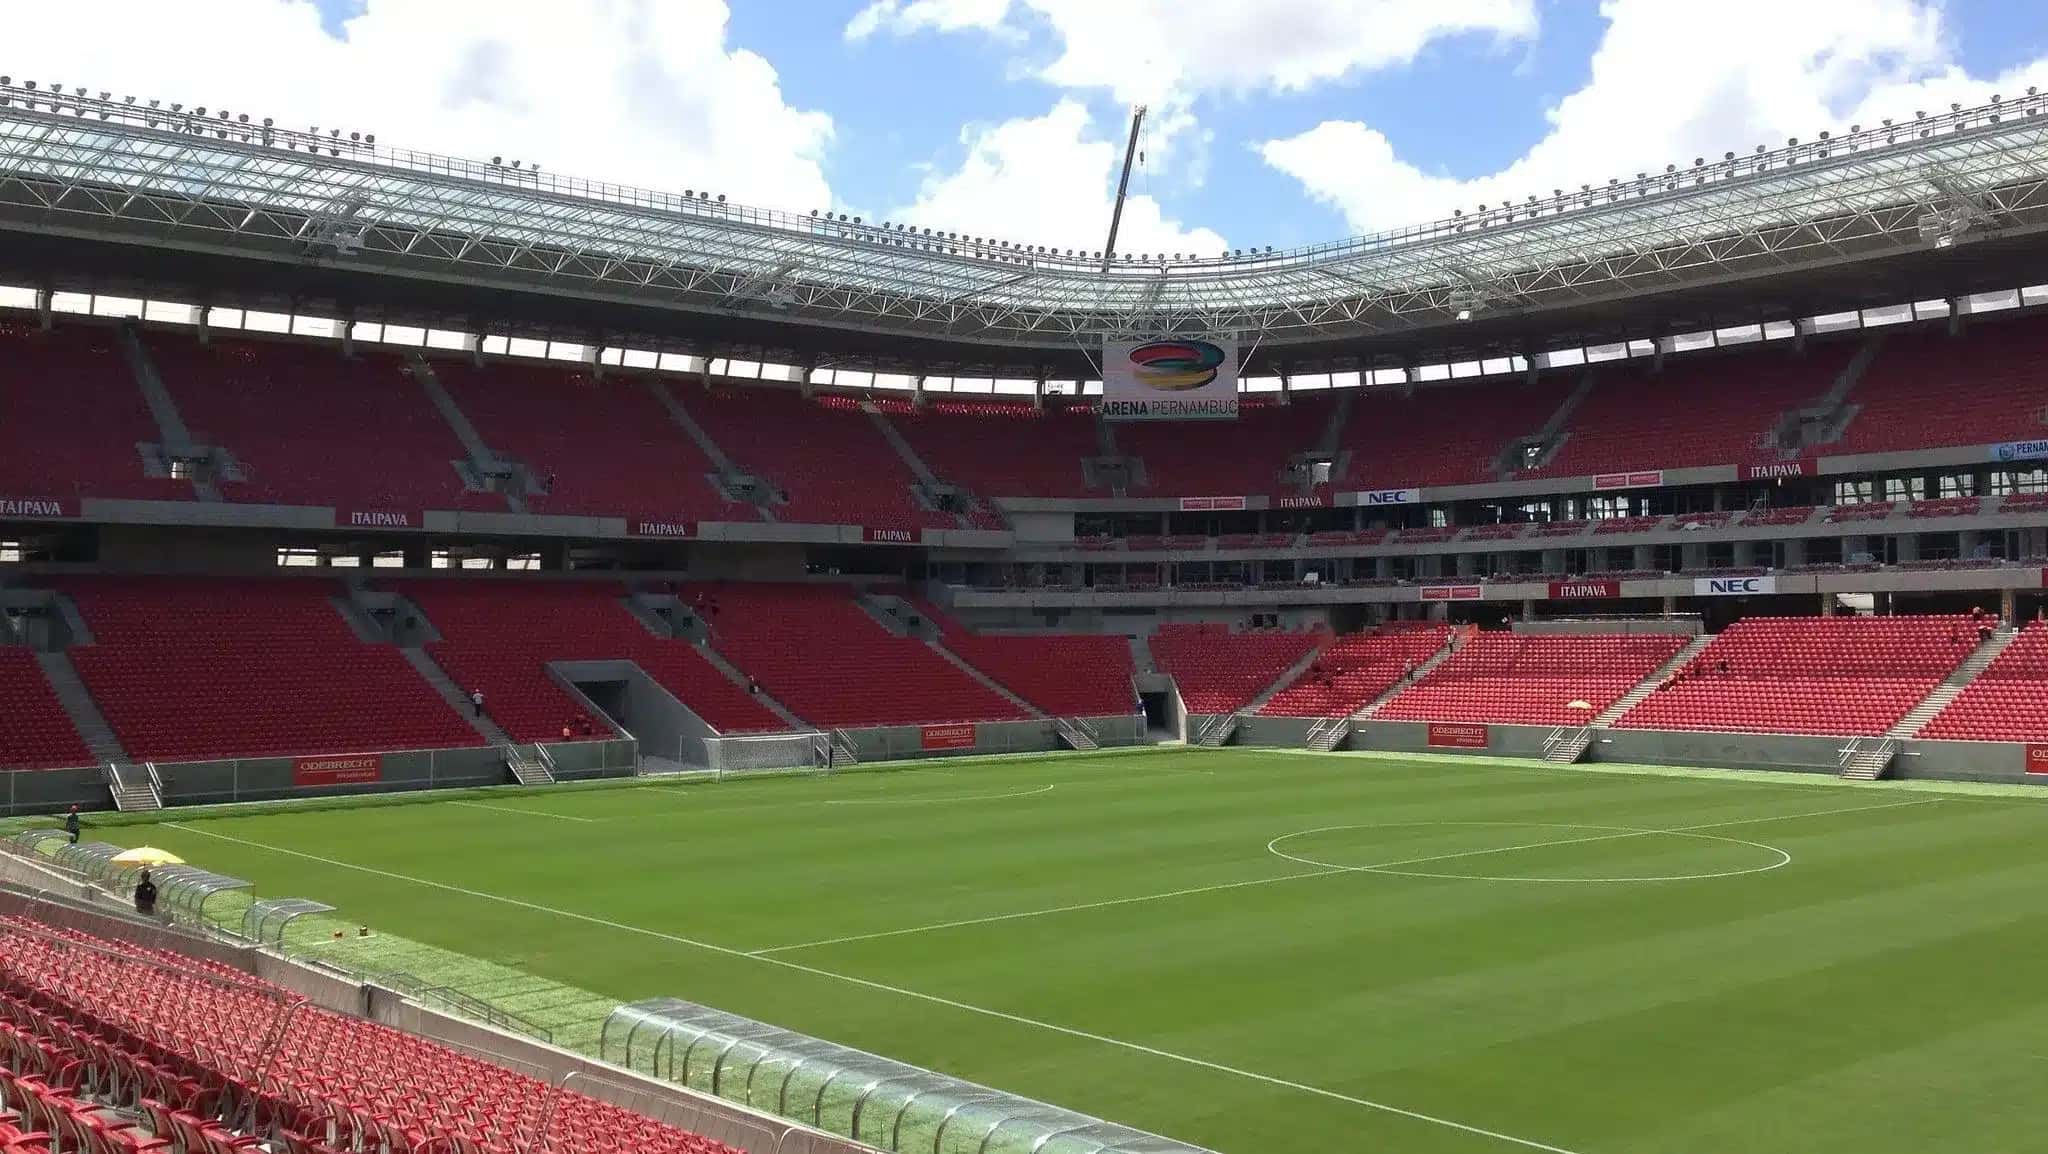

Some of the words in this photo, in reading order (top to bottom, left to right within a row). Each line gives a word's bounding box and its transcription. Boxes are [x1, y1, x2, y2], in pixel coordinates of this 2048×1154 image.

[1103, 400, 1147, 416] ARENA
[1751, 463, 1802, 478] ITAIPAVA
[1280, 497, 1322, 508] ITAIPAVA
[1369, 490, 1407, 504] NEC
[352, 511, 408, 526] ITAIPAVA
[640, 522, 686, 536] ITAIPAVA
[873, 529, 912, 541] ITAIPAVA
[1560, 585, 1607, 597] ITAIPAVA
[1710, 578, 1759, 593] NEC
[300, 759, 376, 770] ODEBRECHT
